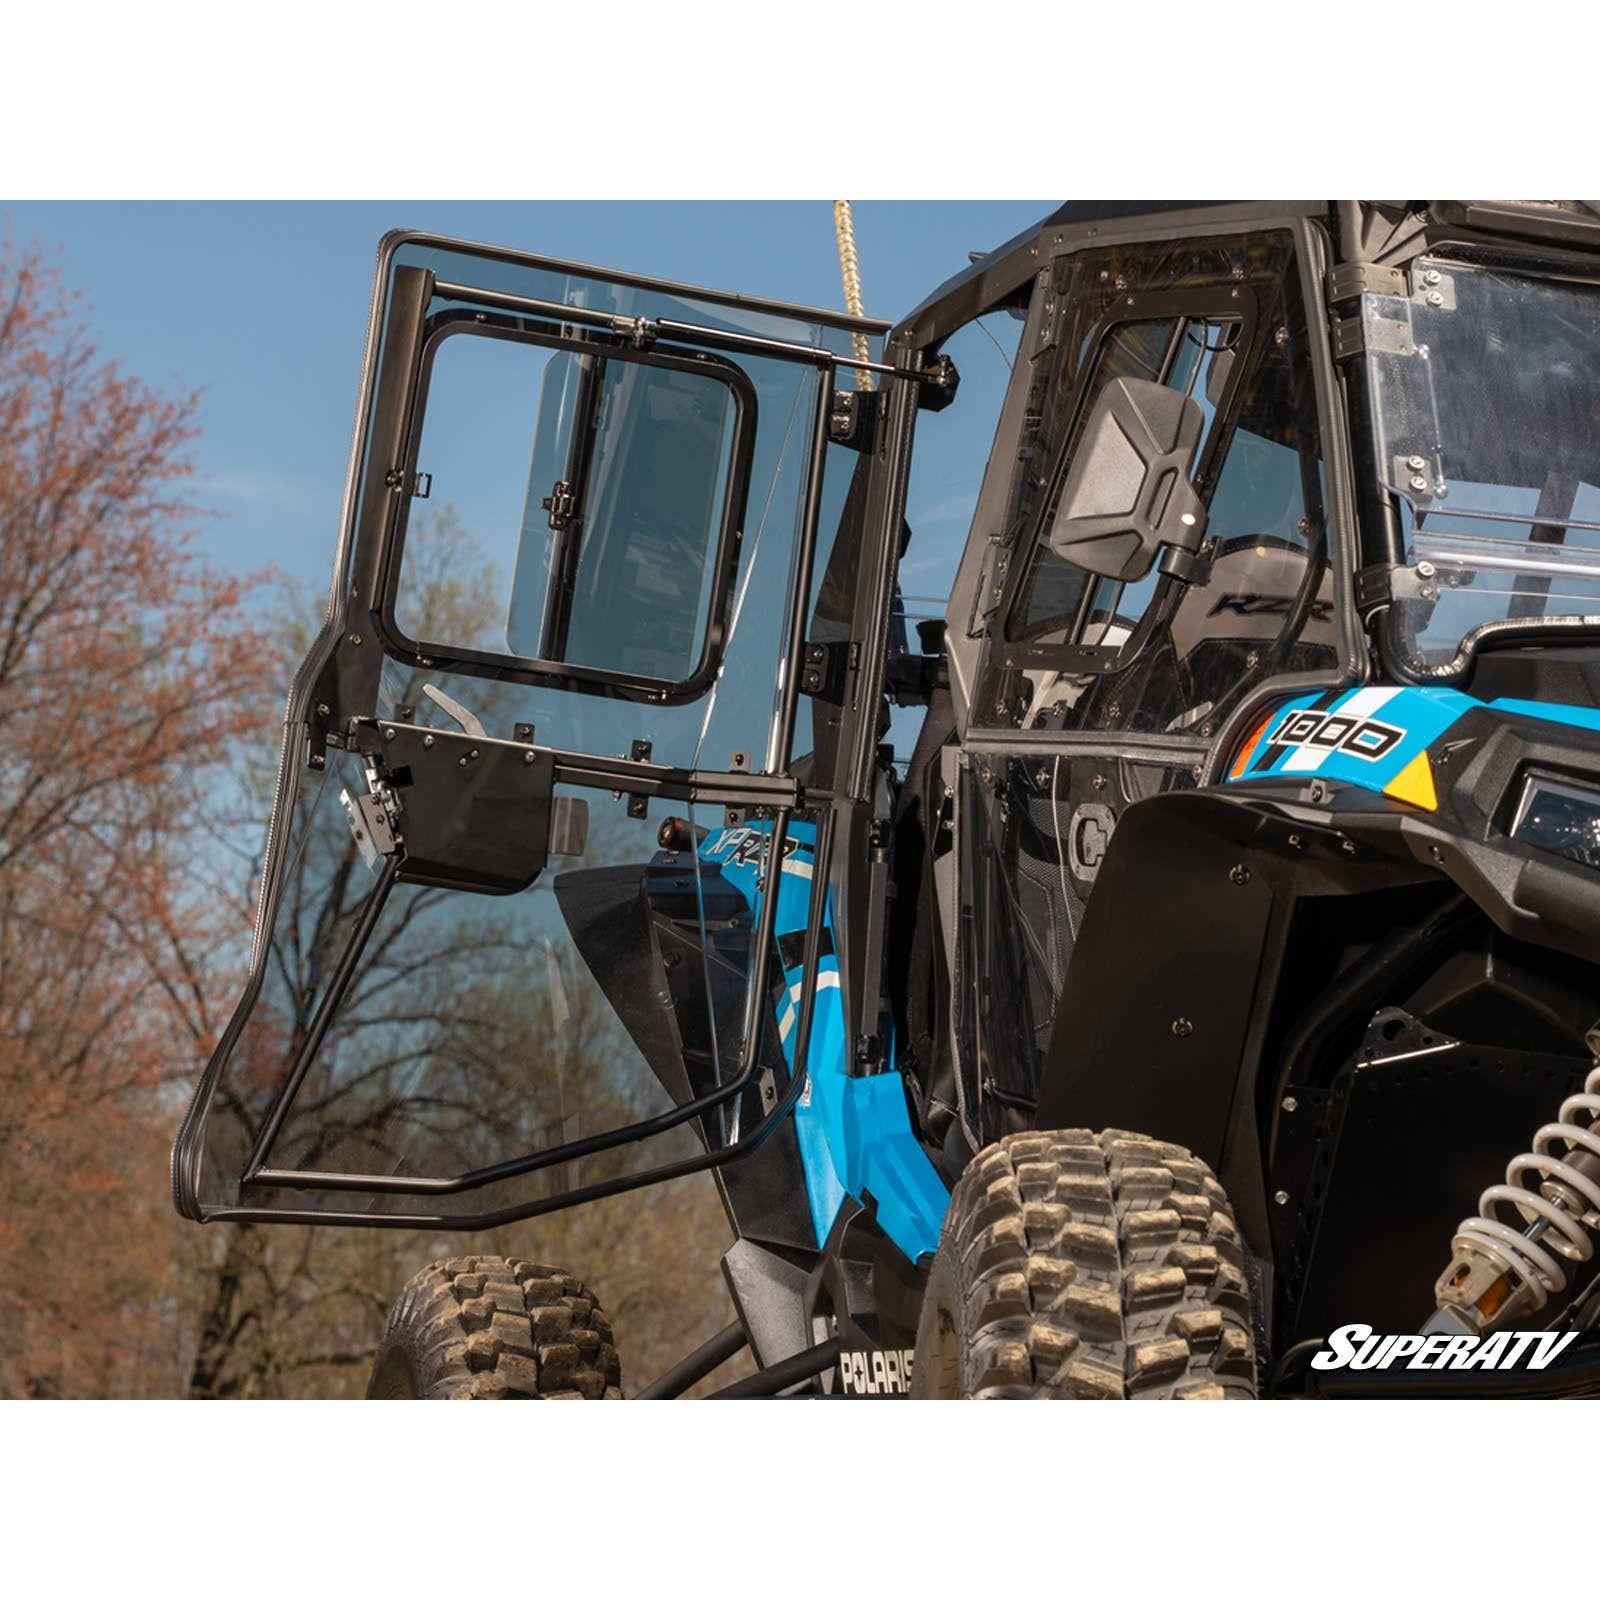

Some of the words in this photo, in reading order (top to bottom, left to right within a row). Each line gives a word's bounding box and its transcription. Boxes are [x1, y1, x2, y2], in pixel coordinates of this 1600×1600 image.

[1268, 711, 1405, 761] 1000
[704, 828, 752, 855] XP
[840, 1349, 915, 1394] POLARIS
